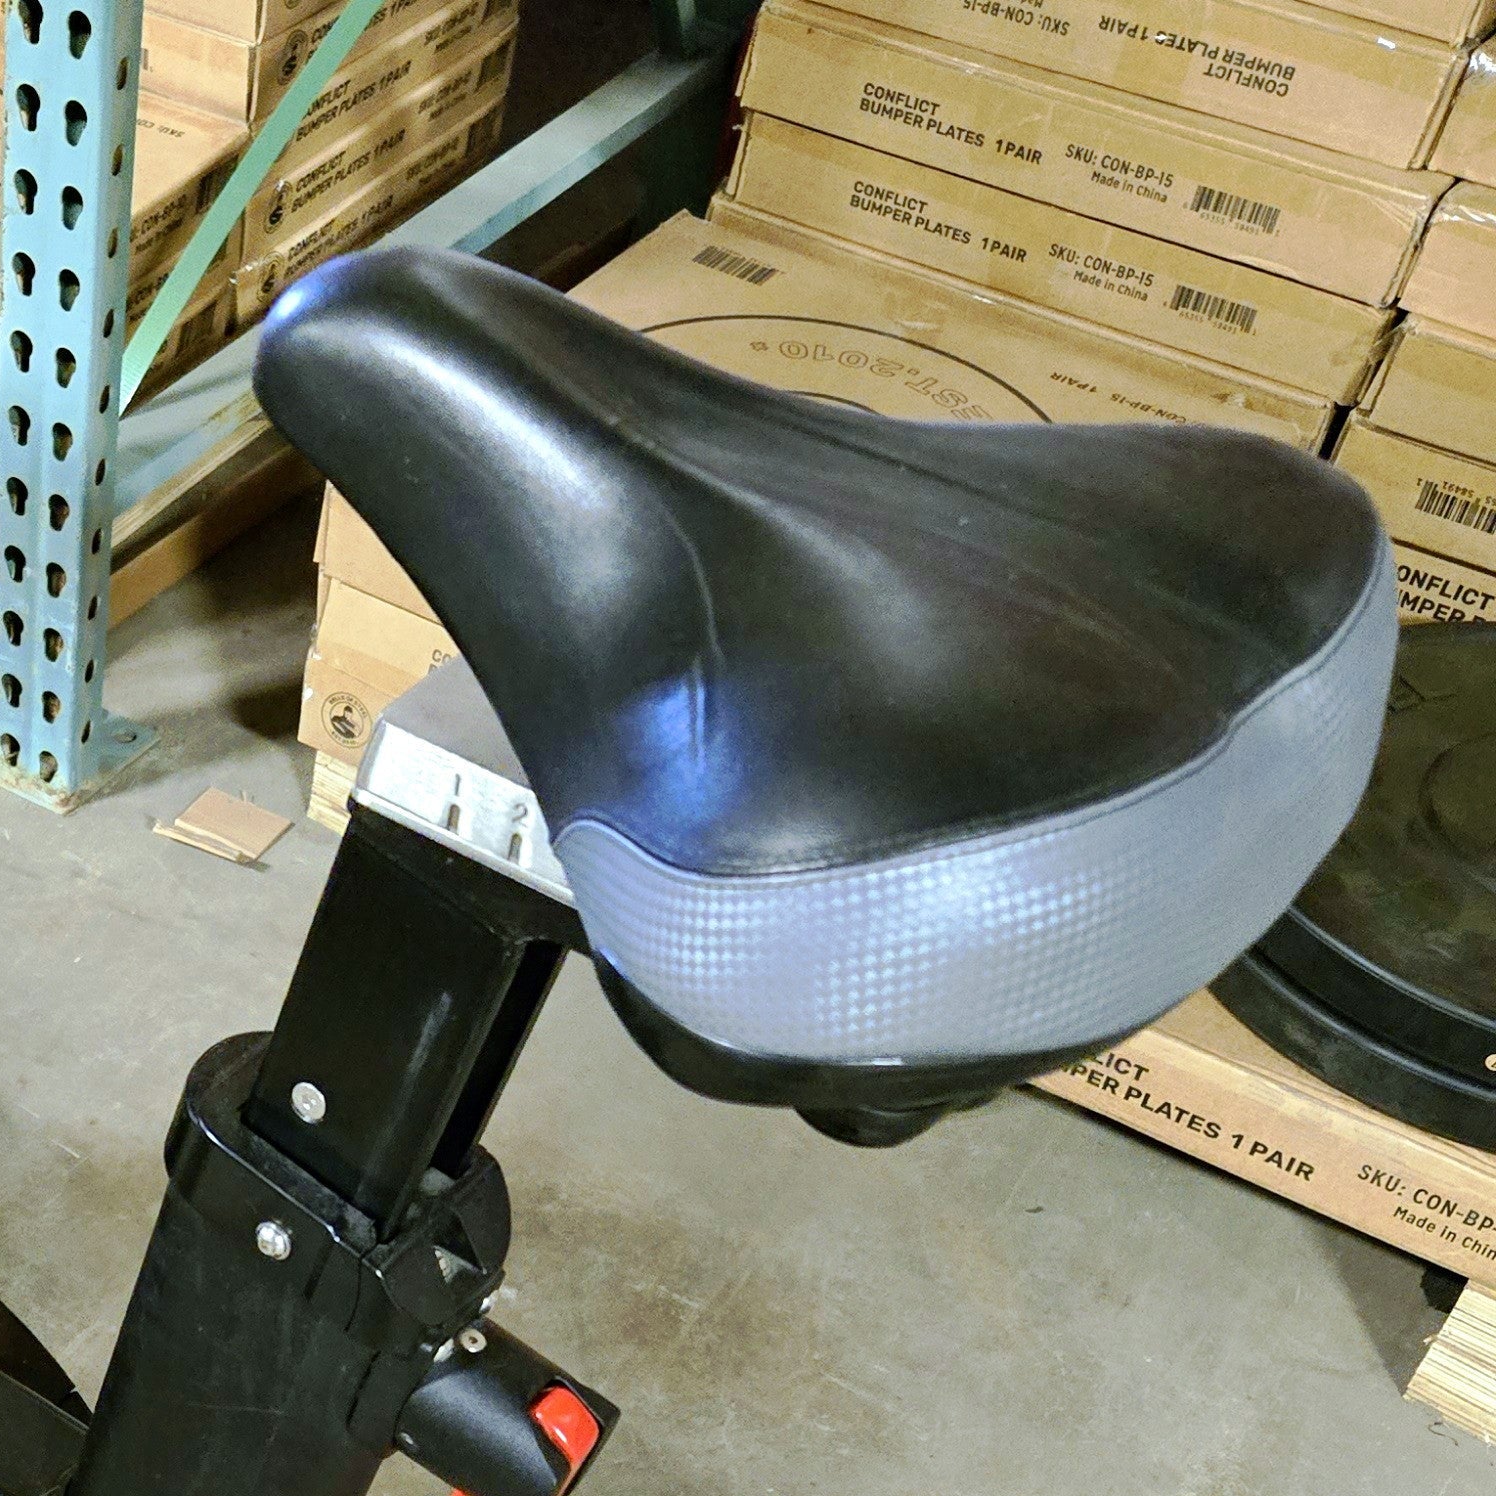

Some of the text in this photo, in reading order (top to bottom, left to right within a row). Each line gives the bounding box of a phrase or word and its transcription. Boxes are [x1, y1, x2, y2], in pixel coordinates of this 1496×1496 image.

[1038, 16, 1071, 36] SKU:
[1098, 14, 1140, 38] PAIR
[1154, 29, 1218, 61] PLATES
[1221, 44, 1296, 81] BUMPER
[1203, 62, 1290, 98] CONFLICT
[863, 82, 940, 116] CONFLICT
[859, 97, 924, 129] BUMPER
[926, 118, 985, 148] PLATES
[1004, 141, 1043, 165] PAIR
[295, 150, 347, 192] CONFLICT
[1065, 143, 1175, 188] SKU: CON-BP-15
[853, 181, 928, 214] CONFLICT
[1090, 171, 1169, 203] Made in China
[850, 194, 912, 226] BUMPER
[914, 215, 971, 245] PLATES
[990, 239, 1027, 263] PAIR
[1048, 243, 1156, 287] SKU: CON-BP-15
[1073, 270, 1149, 302] Made in China
[1050, 371, 1089, 392] PAIR
[1442, 480, 1475, 499] 58491
[511, 803, 528, 828] 2
[1123, 1085, 1222, 1140] PLATES
[1248, 1140, 1316, 1182] PAIR
[1357, 1164, 1406, 1197] SKU:
[1392, 1206, 1436, 1233] Made
[1440, 1225, 1457, 1243] in
